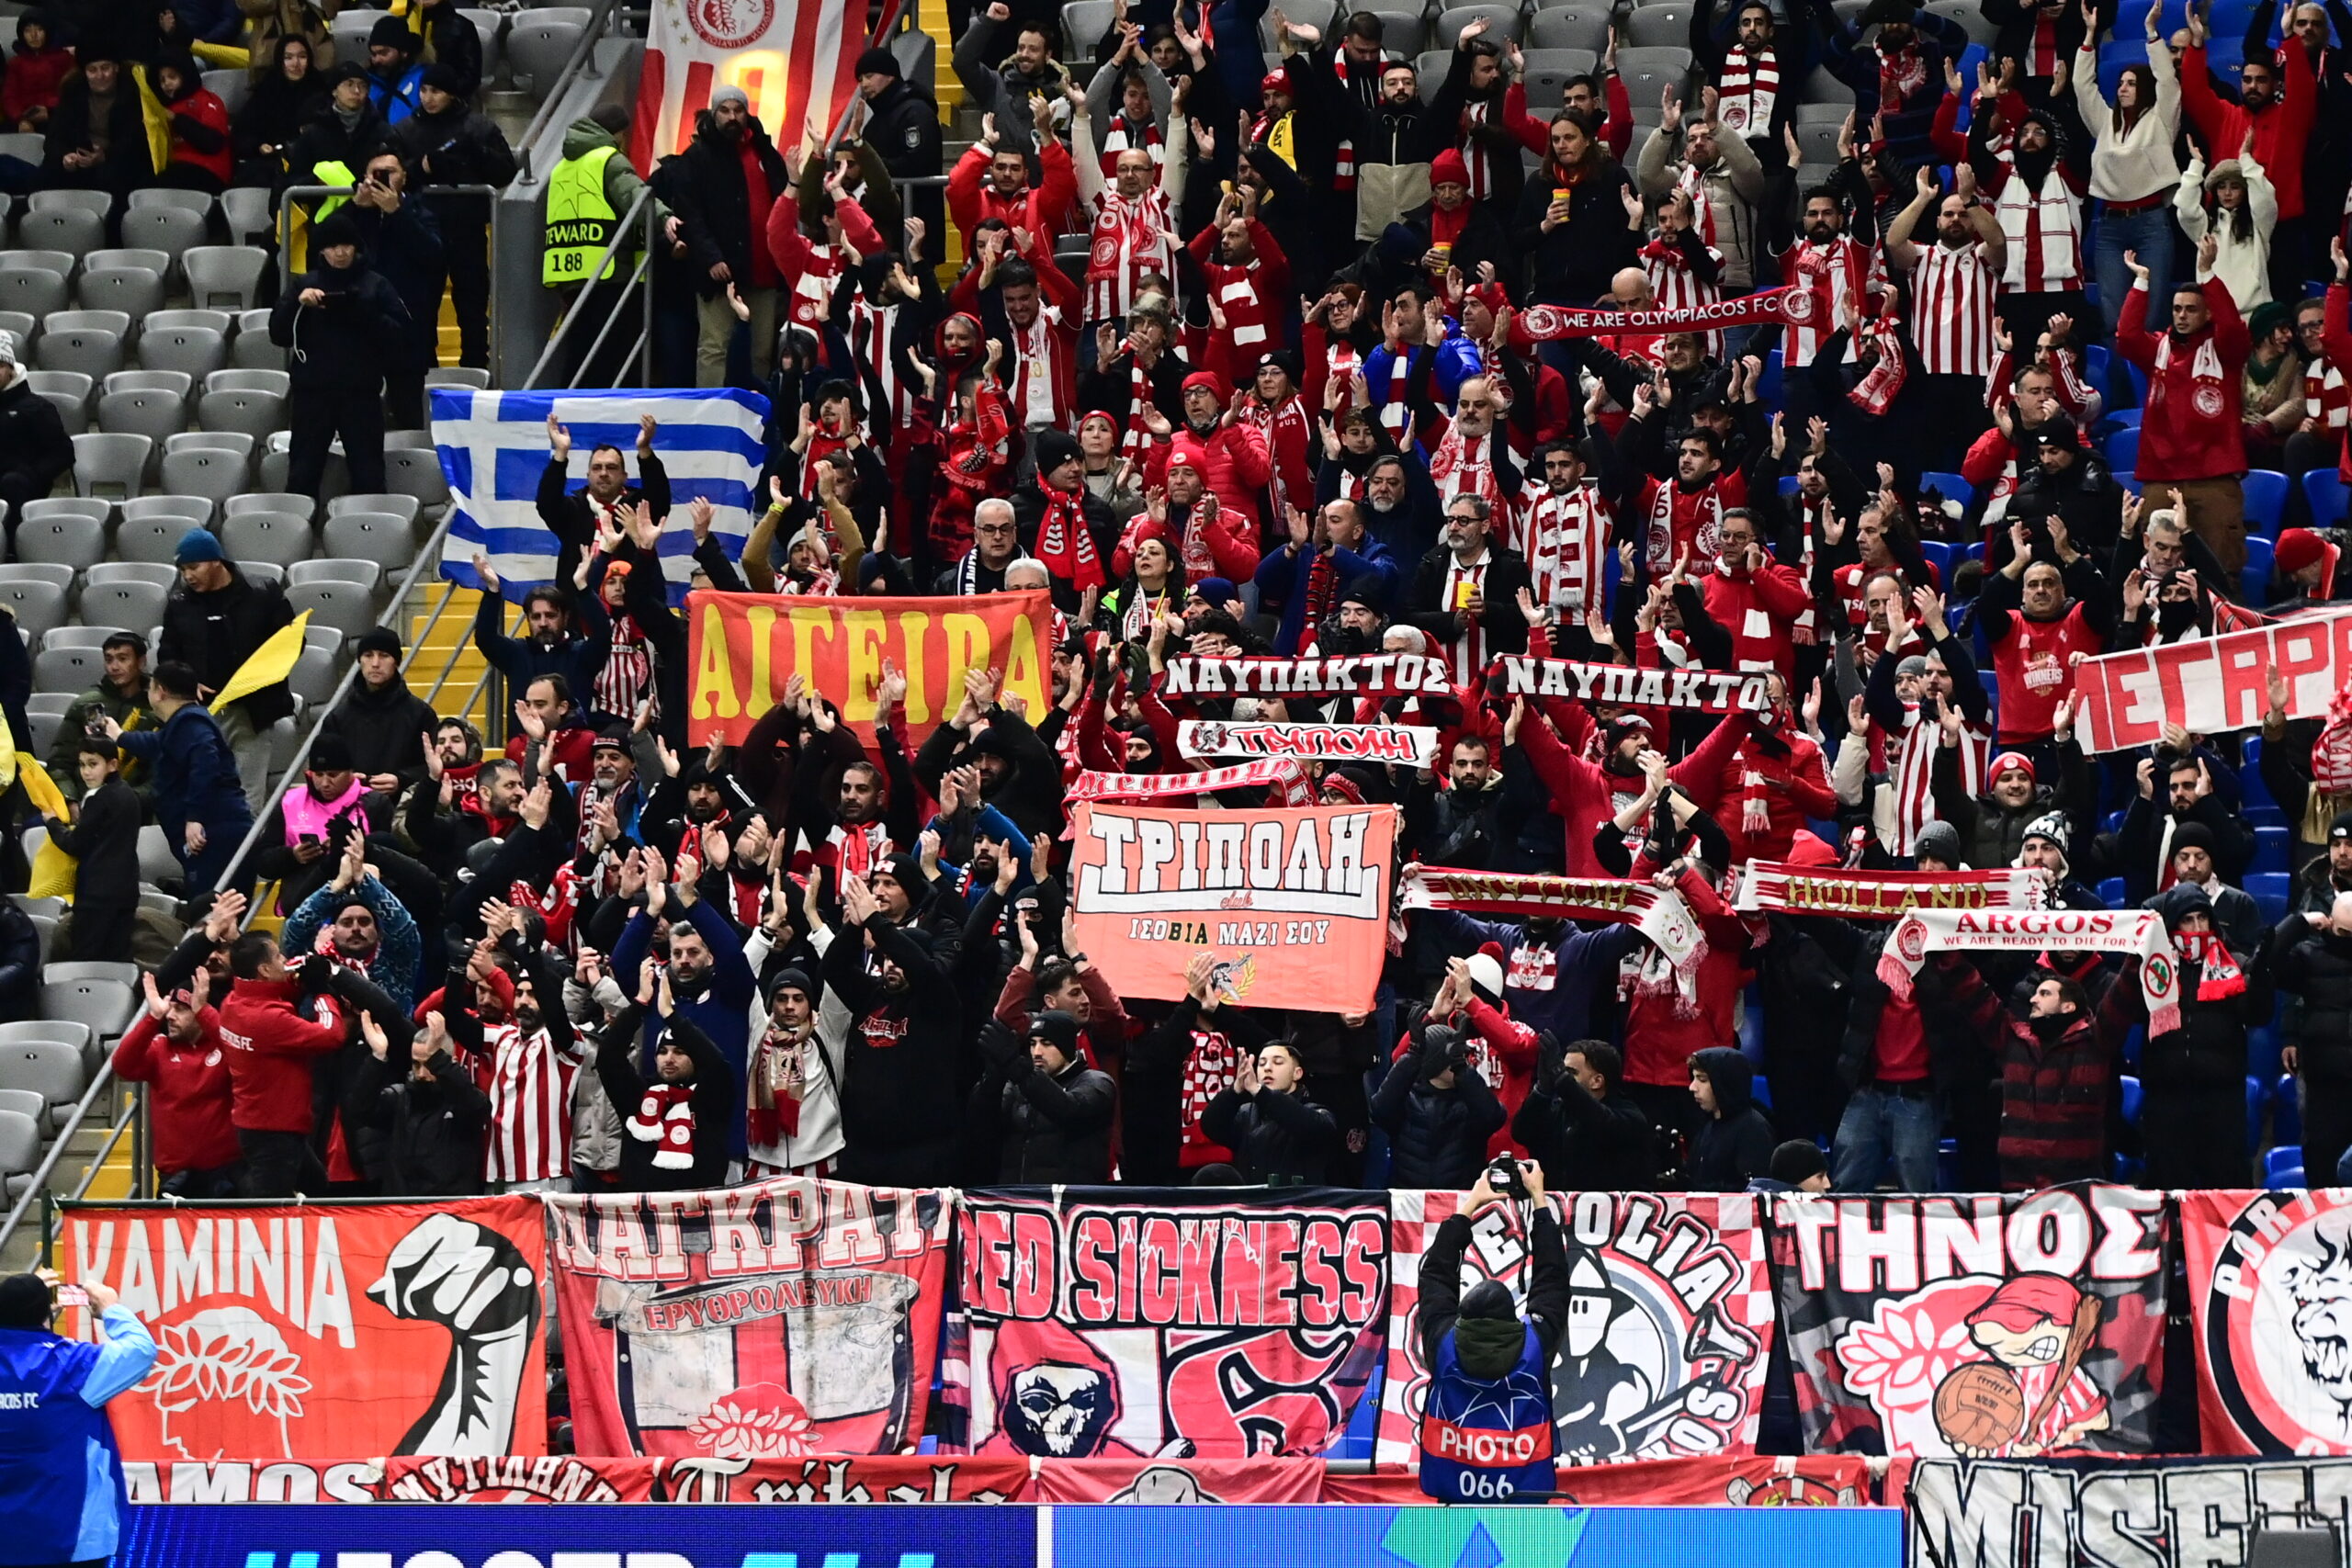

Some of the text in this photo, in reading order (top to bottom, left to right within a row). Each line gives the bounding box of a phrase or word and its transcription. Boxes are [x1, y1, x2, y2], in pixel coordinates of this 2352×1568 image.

[552, 253, 582, 272] 188
[1563, 298, 1779, 328] WE ARE OLYMPIACOS FC
[691, 603, 1047, 727] ΑΙΓΕΙΡΑ
[1166, 654, 1451, 694] ΝΑΥΠΑΚΤΟΣ
[1091, 811, 1372, 897] ΤΡΙΠΟΛΗ
[1219, 888, 1254, 909] club
[1442, 874, 1637, 911] HOLLAND
[1784, 875, 1987, 910] HOLLAND
[1129, 918, 1330, 946] ΙΣΟΒΙΑ ΜΑΖΙ ΣΟΥ
[1955, 913, 2115, 935] ARGOS
[1943, 936, 1963, 945] WE
[1970, 936, 1996, 945] ARE
[2002, 936, 2044, 946] READY
[2052, 936, 2067, 946] TO
[2075, 936, 2097, 946] DIE
[2103, 937, 2126, 947] FOR
[1775, 1184, 2165, 1292] ΤΗΝΟΣ
[73, 1215, 356, 1348] KAMINIA
[1073, 1214, 1385, 1325] SICKNESS
[643, 1275, 873, 1331] ΕΡΥΘΡΟΛΕΥΚΗ
[23, 1392, 40, 1409] FC
[1441, 1427, 1535, 1461] PHOTO
[1459, 1471, 1513, 1499] 066
